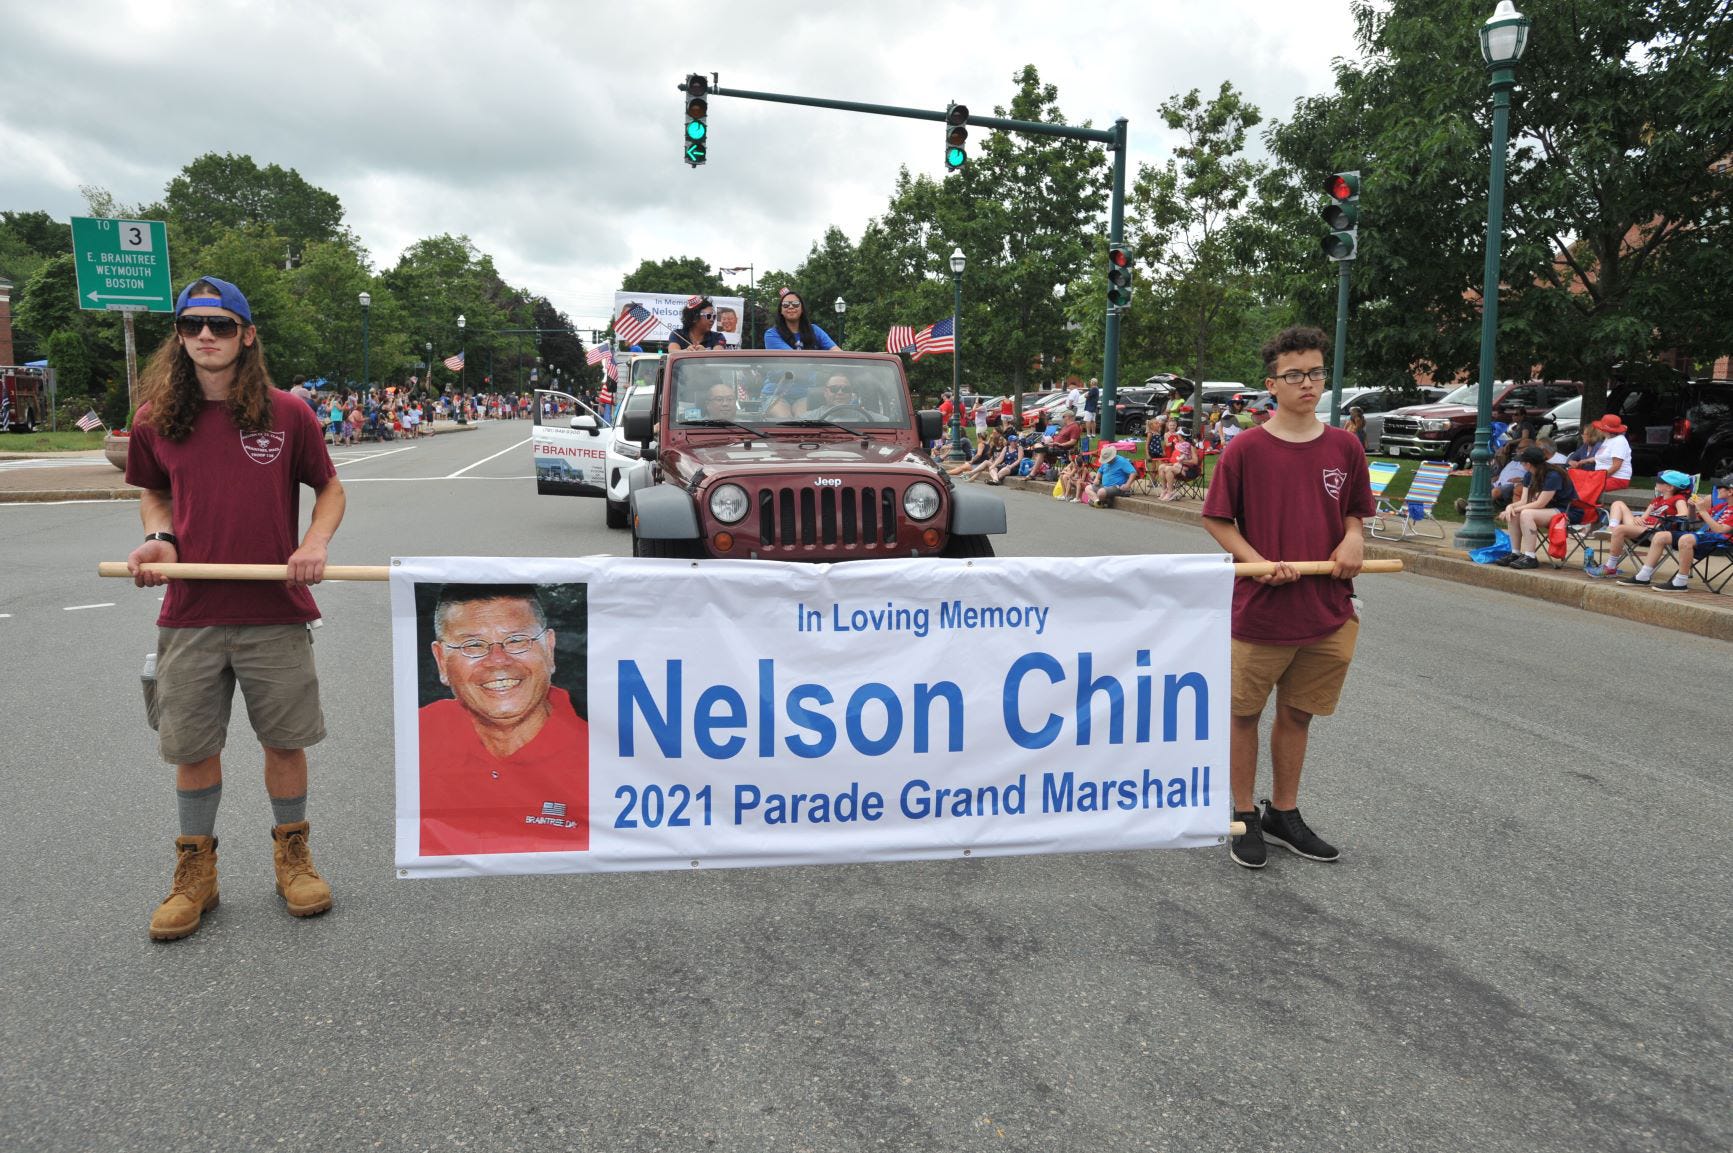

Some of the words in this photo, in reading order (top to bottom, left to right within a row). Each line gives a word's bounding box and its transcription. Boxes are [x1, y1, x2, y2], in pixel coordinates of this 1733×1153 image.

[96, 220, 110, 230] TO
[129, 227, 142, 246] 3
[87, 252, 97, 262] E.
[101, 252, 157, 265] BRAINTREE
[96, 265, 152, 277] WEYMOUTH
[105, 278, 145, 289] BOSTON
[542, 446, 606, 460] BRAINTREE
[814, 476, 842, 487] Jeep
[797, 604, 823, 633] In
[833, 603, 929, 638] Loving
[940, 600, 1048, 636] Memory
[617, 658, 965, 760] Nelson
[1003, 648, 1211, 751] Chin
[614, 783, 713, 830] 2021
[735, 783, 885, 826] Parade
[900, 778, 1026, 820] Grand
[1042, 766, 1212, 814] Marshall
